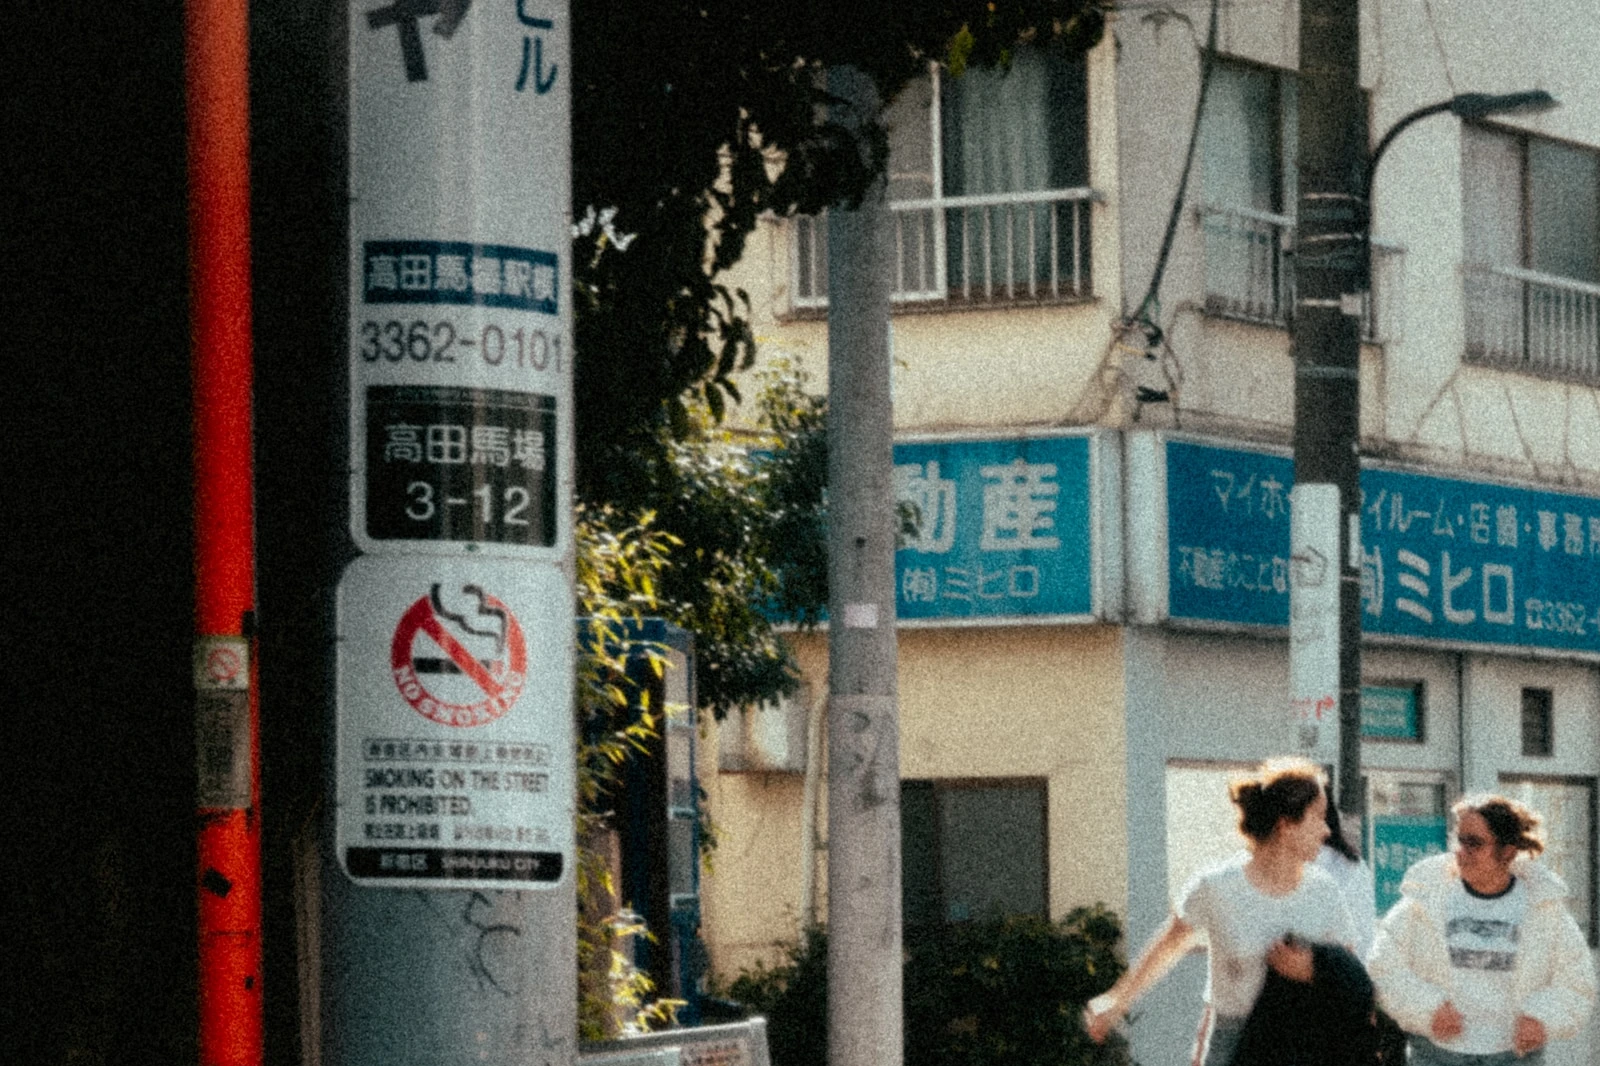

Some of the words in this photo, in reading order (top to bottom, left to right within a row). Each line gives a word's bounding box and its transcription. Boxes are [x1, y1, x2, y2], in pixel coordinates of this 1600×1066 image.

[361, 320, 562, 374] 3362-0101
[384, 421, 544, 471] 高田馬場
[405, 480, 530, 525] 3-12
[439, 770, 465, 790] ON
[471, 771, 499, 791] THE
[505, 772, 549, 793] STREET
